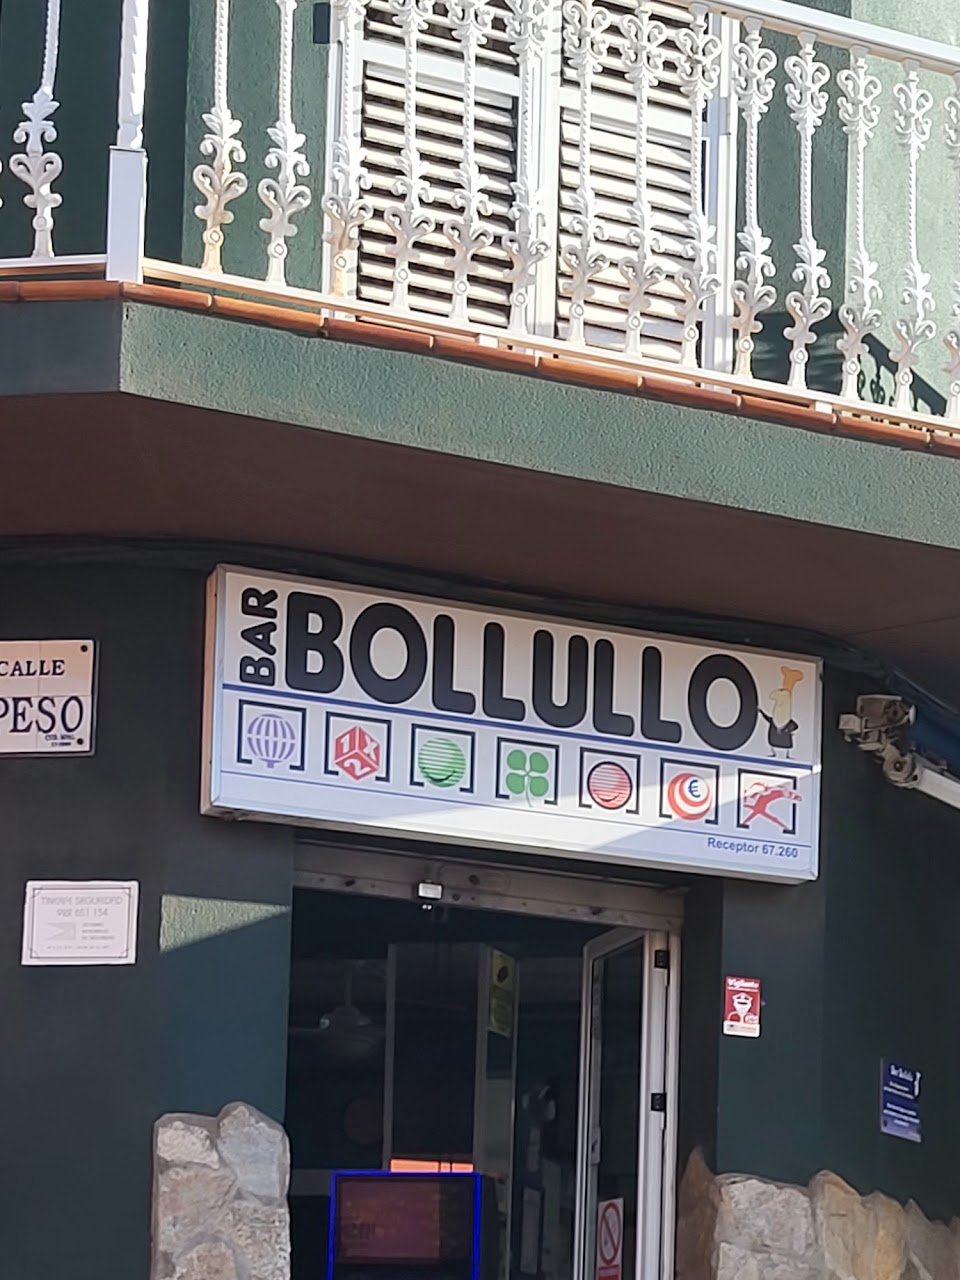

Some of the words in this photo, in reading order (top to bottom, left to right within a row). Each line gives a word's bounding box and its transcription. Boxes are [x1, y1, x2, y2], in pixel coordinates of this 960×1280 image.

[239, 587, 278, 686] BAR
[0, 659, 66, 677] CALLE
[284, 591, 759, 751] BOLLULLO
[707, 836, 760, 854] Receptor
[762, 846, 799, 858] 67.260
